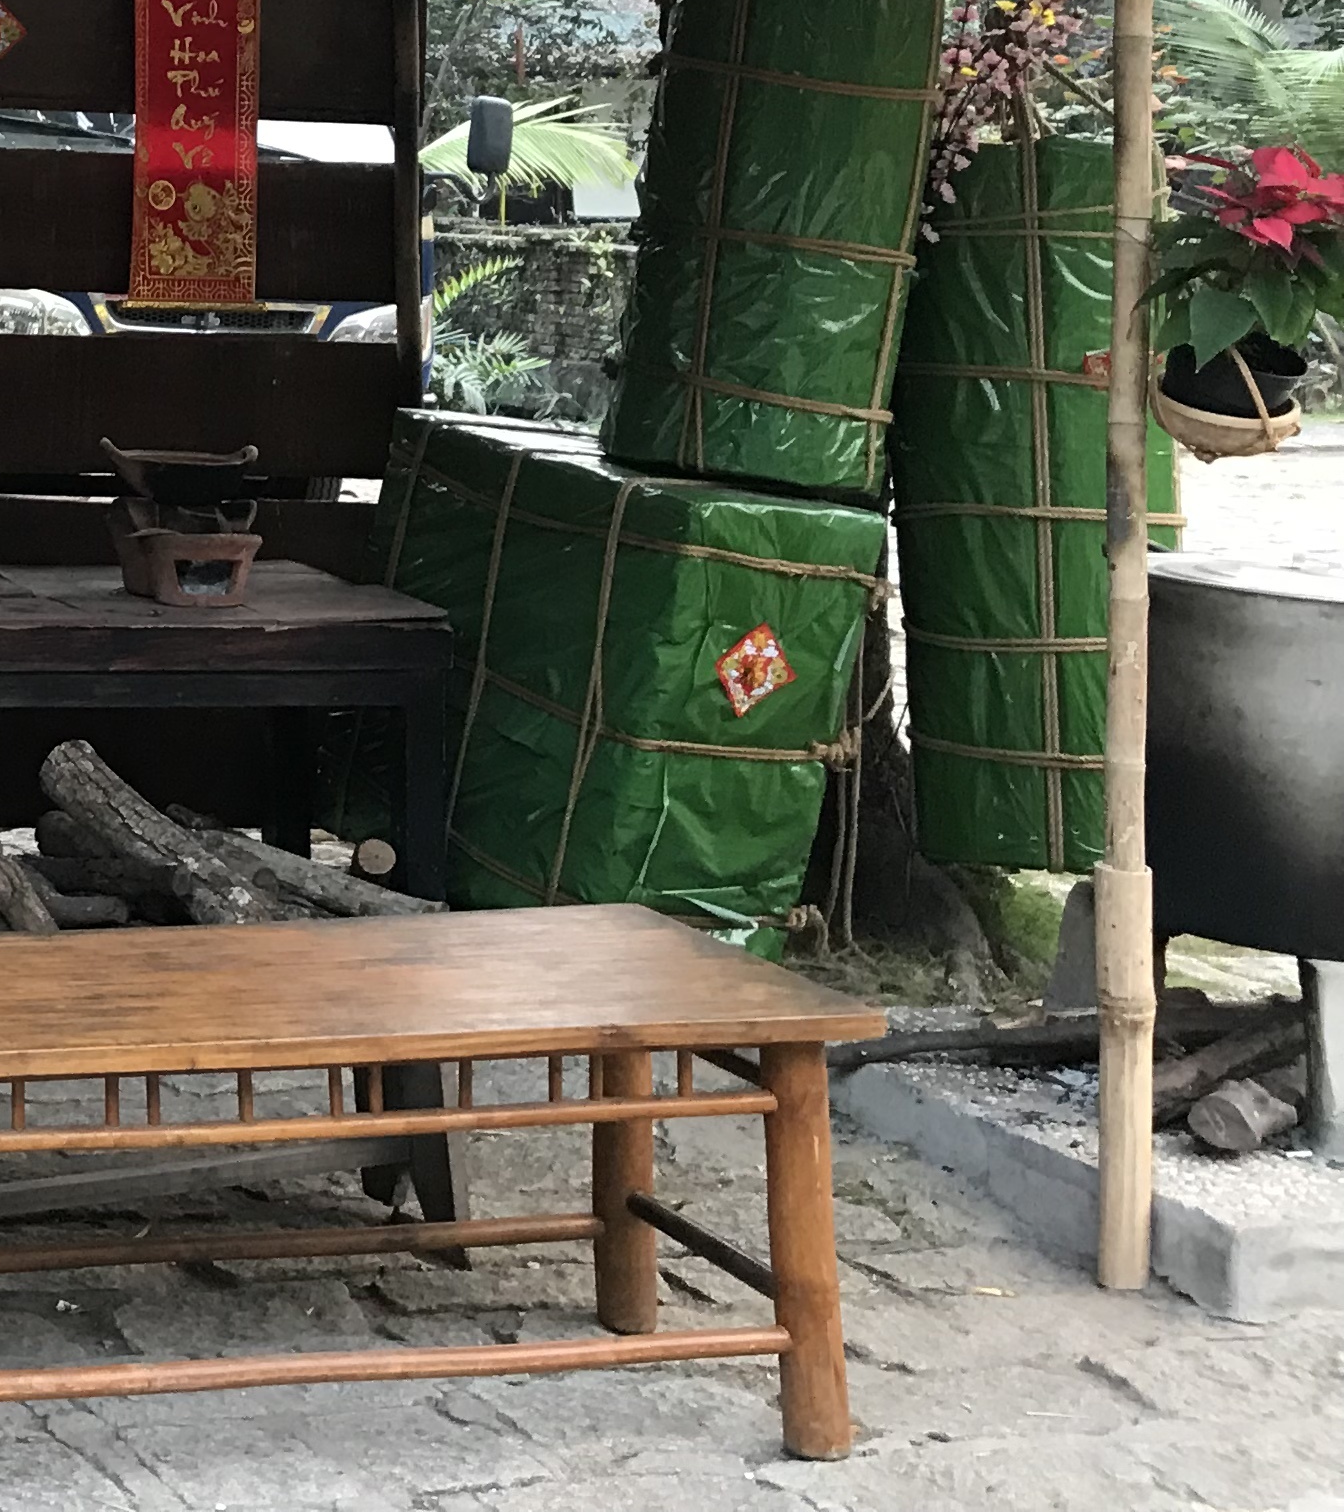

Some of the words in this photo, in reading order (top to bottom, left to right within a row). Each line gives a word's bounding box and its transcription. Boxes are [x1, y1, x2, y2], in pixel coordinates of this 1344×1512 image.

[161, 0, 228, 27] Vinh
[169, 37, 221, 66] Hoa
[166, 69, 225, 98] Phú
[170, 103, 220, 140] Quý
